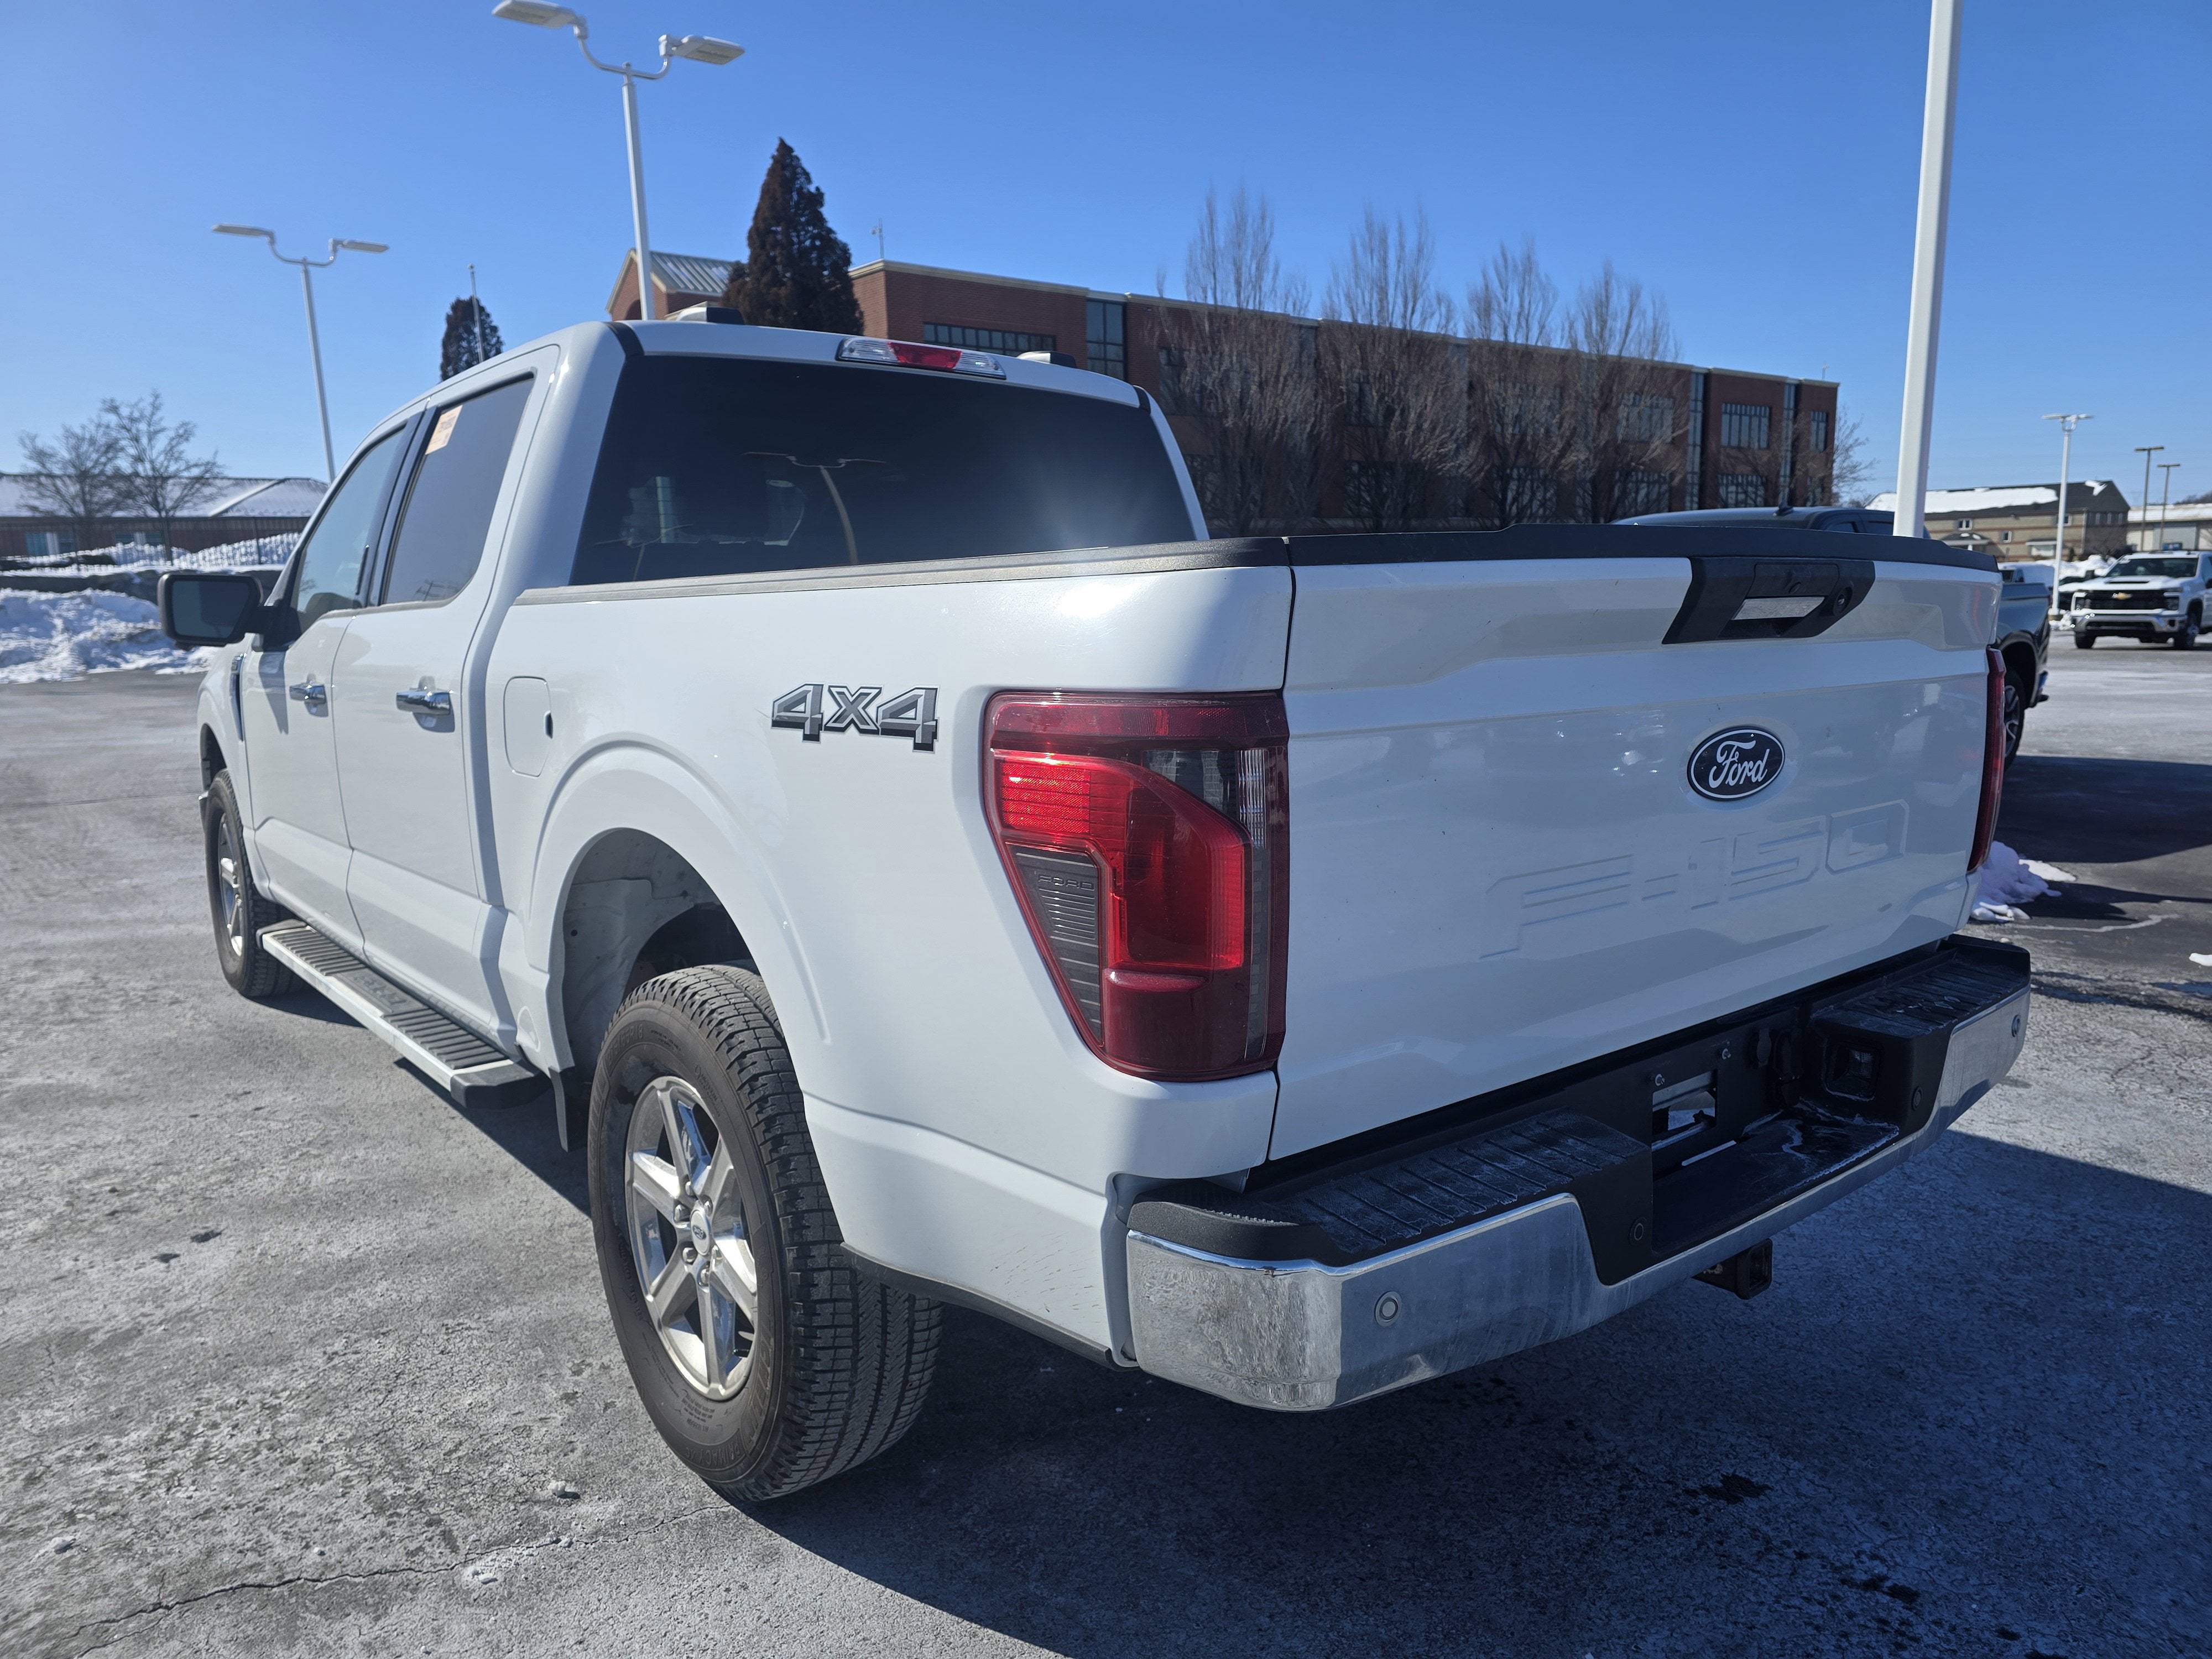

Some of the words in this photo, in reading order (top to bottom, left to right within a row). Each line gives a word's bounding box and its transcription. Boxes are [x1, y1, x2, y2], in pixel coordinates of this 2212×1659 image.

[1708, 739, 1770, 789] Ford
[1038, 874, 1095, 891] FORD
[1479, 799, 1910, 959] F-150
[698, 1442, 740, 1467] PRIMACY
